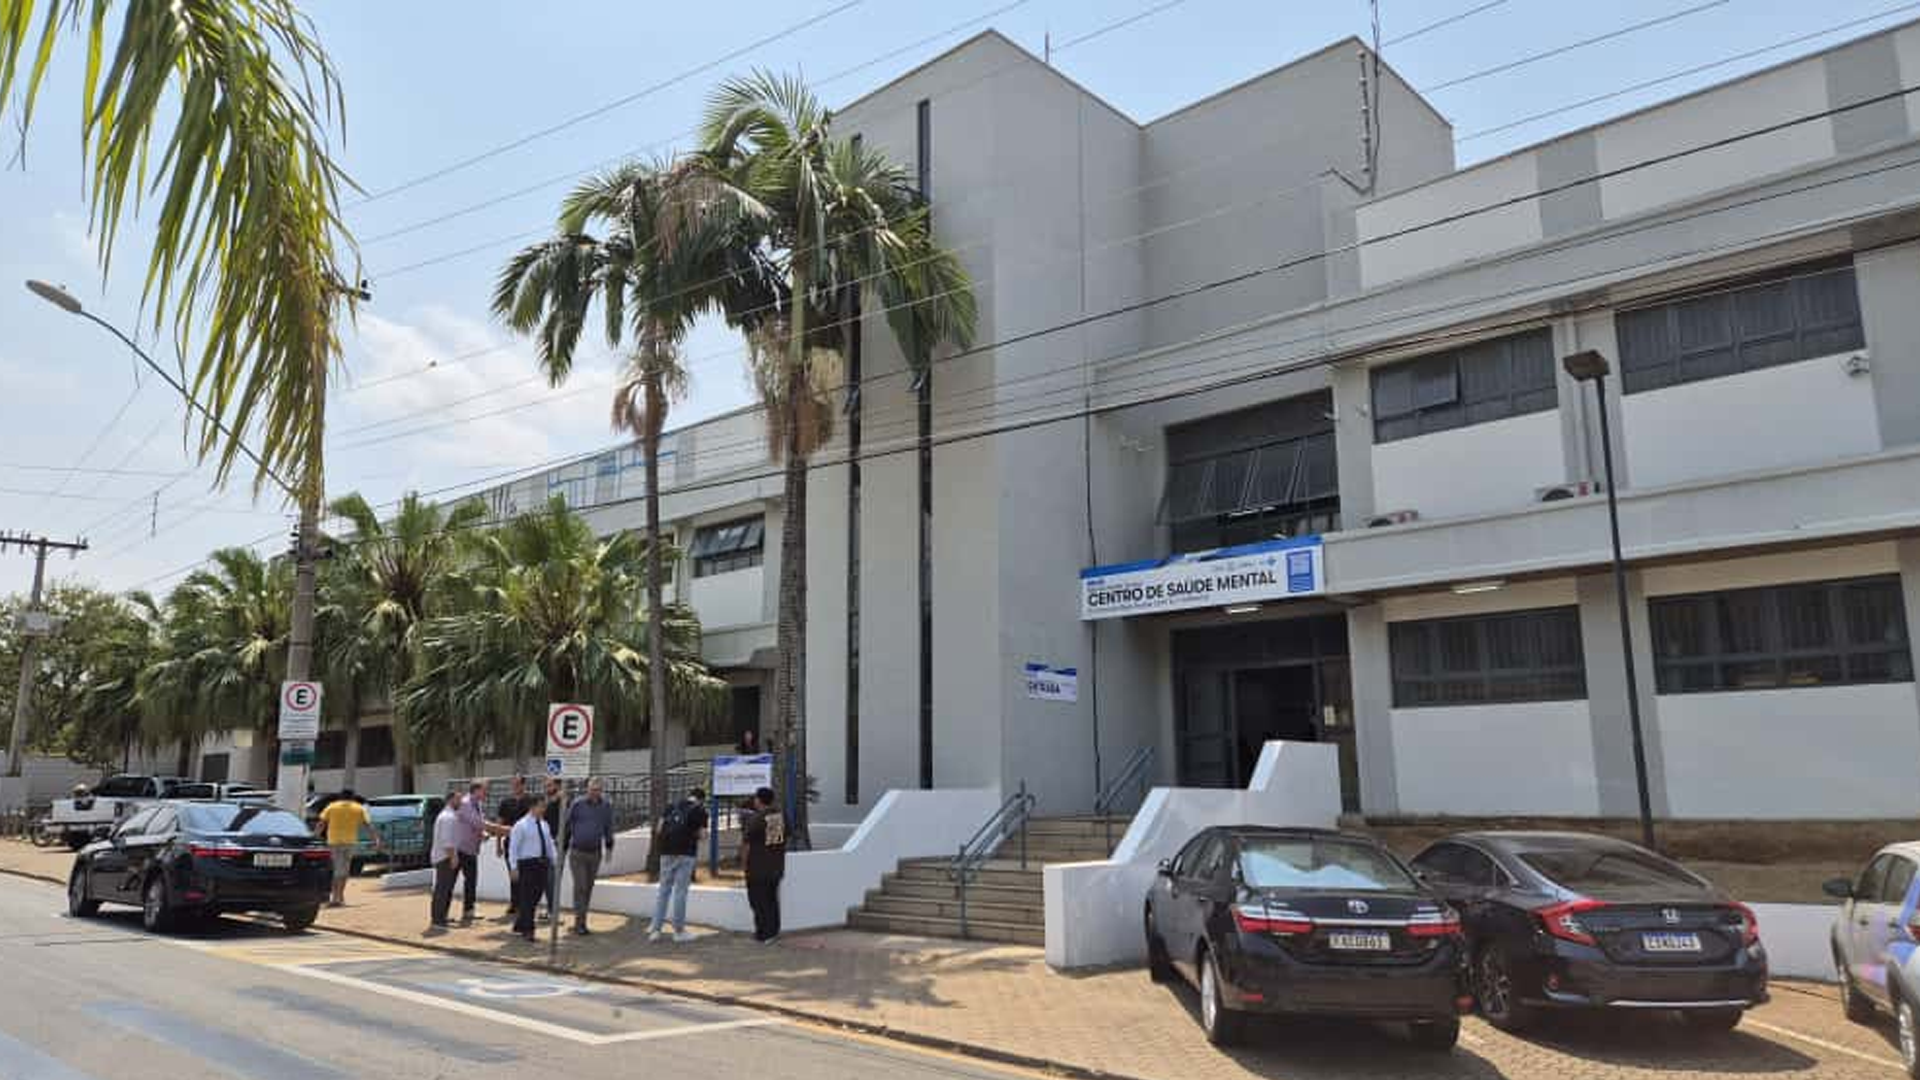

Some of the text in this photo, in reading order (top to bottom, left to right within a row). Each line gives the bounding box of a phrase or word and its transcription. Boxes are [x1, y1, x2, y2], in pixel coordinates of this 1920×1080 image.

[1088, 588, 1143, 607] CENTRO
[1146, 585, 1164, 599] DE
[1217, 571, 1277, 592] MENTAL
[296, 688, 308, 705] E
[562, 715, 579, 739] E
